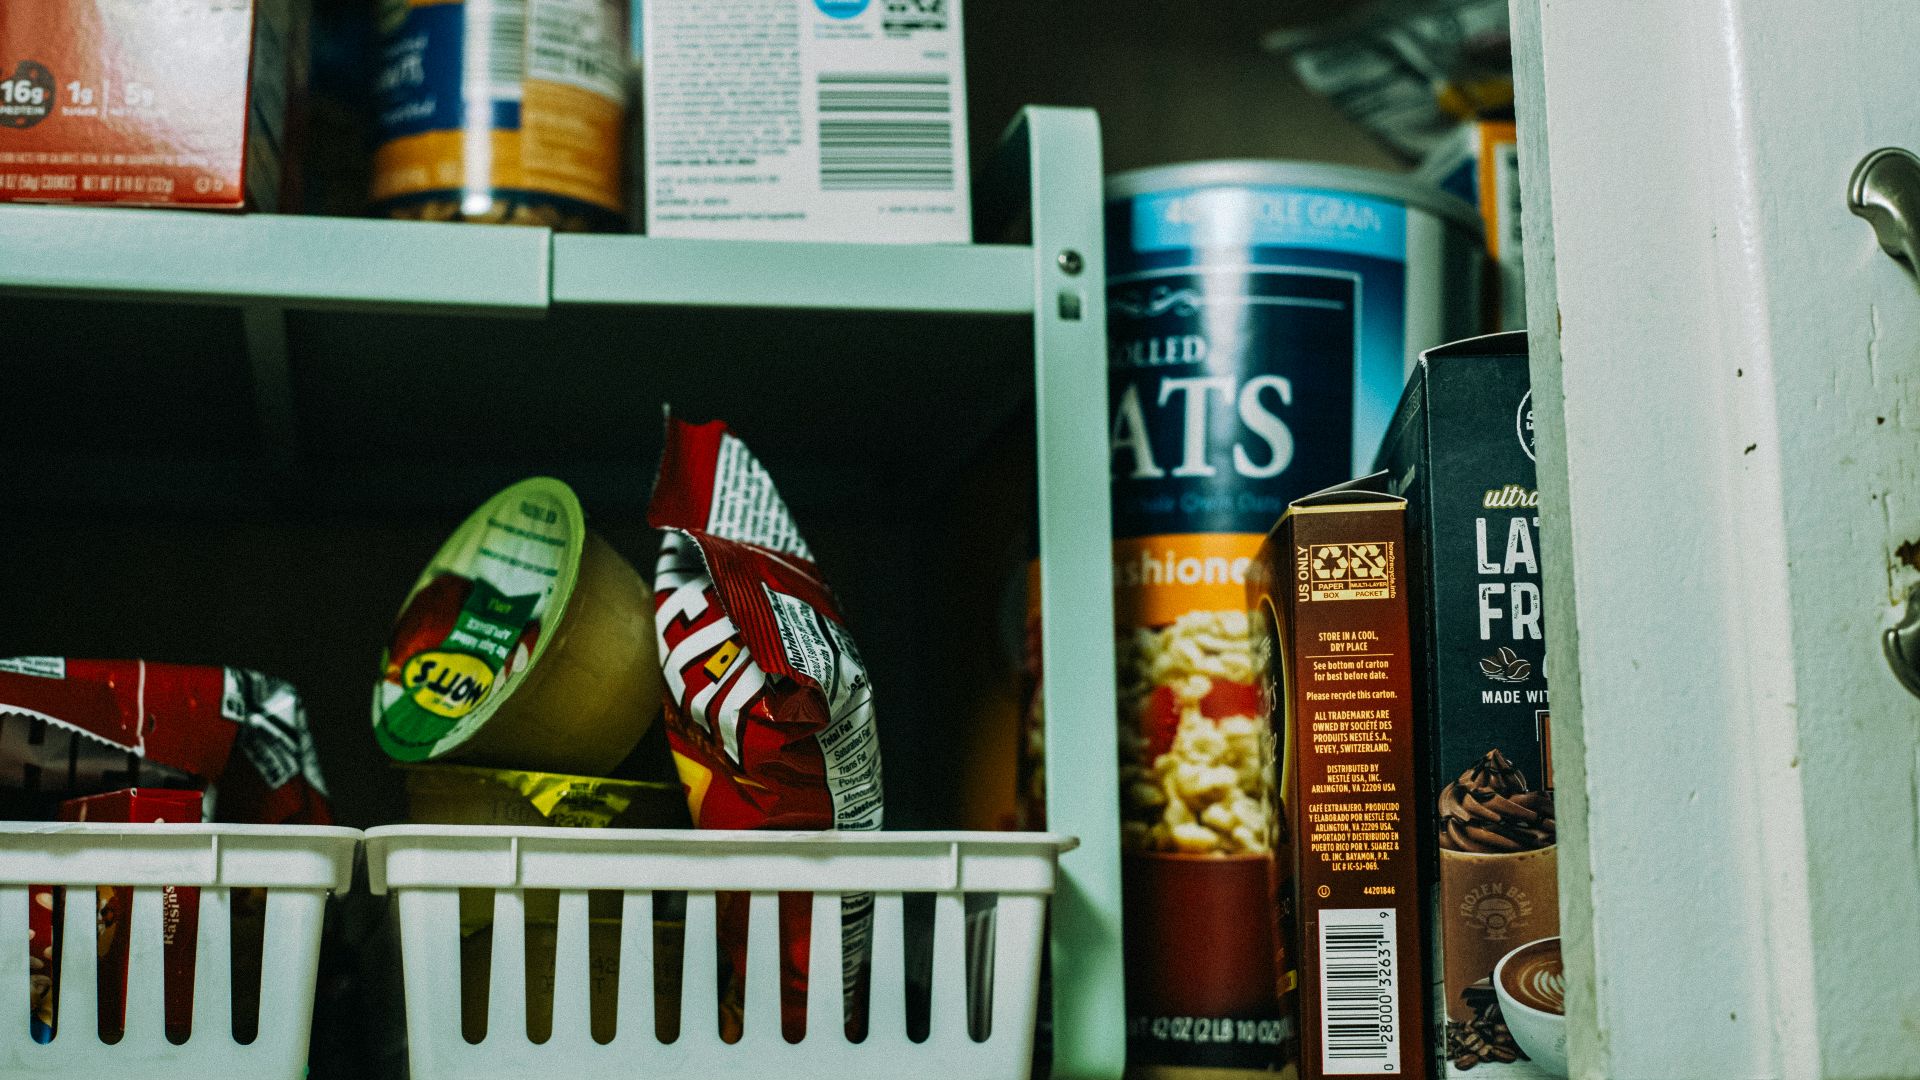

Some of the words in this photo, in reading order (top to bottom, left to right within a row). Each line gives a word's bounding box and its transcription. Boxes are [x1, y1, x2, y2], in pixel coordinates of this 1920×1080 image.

[0, 80, 44, 104] 16g
[66, 81, 93, 105] 1g
[1298, 546, 1309, 580] ONLY
[1388, 542, 1396, 598] how2recycle.info
[1299, 584, 1309, 602] US
[1479, 583, 1542, 640] FR
[1319, 632, 1340, 641] STORE
[1342, 632, 1350, 640] IN
[1352, 632, 1356, 640] A
[1358, 631, 1378, 640] COOL,
[1331, 643, 1345, 652] DRY
[1347, 642, 1368, 651] PLACE
[1314, 662, 1326, 670] See
[1328, 661, 1354, 670] bottom
[1356, 660, 1364, 668] of
[1366, 660, 1388, 668] carton
[1314, 673, 1325, 681] for
[1327, 672, 1342, 680] best
[1344, 671, 1368, 680] before
[1370, 671, 1388, 679] date.
[1306, 692, 1329, 700] Please
[1331, 691, 1356, 700] recycle
[1358, 690, 1370, 699] this
[1372, 690, 1397, 698] carton.
[1482, 691, 1520, 704] MADE
[1315, 712, 1327, 720] ALL
[1328, 710, 1374, 720] TRADEMARKS
[1376, 710, 1389, 718] ARE
[1313, 723, 1338, 731] OWNED
[1340, 722, 1349, 730] BY
[1351, 720, 1378, 730] SOCIÉTÉ
[1379, 721, 1392, 729] DES
[821, 728, 840, 748] Total
[839, 720, 853, 733] Fat
[1313, 733, 1348, 742] PRODUITS
[1350, 731, 1373, 741] NESTLÉ
[1375, 732, 1392, 742] S.A.,
[834, 734, 862, 761] Saturated
[1315, 745, 1339, 754] VEVEY,
[1340, 744, 1391, 752] SWITZERLAND.
[838, 759, 857, 775] Trans
[857, 751, 867, 765] Fat
[1327, 764, 1369, 773] DISTRIBUTED
[1370, 764, 1379, 772] BY
[1328, 773, 1350, 783] NESTLÉ
[1352, 775, 1367, 783] USA,
[1312, 785, 1350, 793] ARLINGTON,
[1352, 784, 1360, 792] VA
[1362, 784, 1381, 792] 22209
[1309, 802, 1322, 812] CAFÉ
[1324, 803, 1363, 812] EXTRANJERO.
[1365, 803, 1399, 811] PRODUCIDO
[1309, 814, 1313, 822] Y
[1315, 814, 1349, 822] ELABORADO
[1364, 812, 1384, 821] NESTLÉ
[1386, 813, 1400, 822] USA,
[837, 819, 873, 830] Sodium
[1316, 823, 1351, 832] ARLINGTON,
[1352, 823, 1360, 831] VA
[1311, 833, 1345, 841] IMPORTADO
[1347, 833, 1351, 841] Y
[1352, 832, 1389, 840] DISTRIBUIDO
[1391, 832, 1399, 840] EN
[1312, 843, 1334, 851] PUERTO
[1336, 843, 1349, 851] RICO
[1371, 842, 1393, 850] SUAREZ
[1395, 842, 1399, 850] &
[1321, 853, 1331, 861] CO.
[1333, 853, 1344, 861] INC.
[1346, 852, 1376, 861] BAYAMON,
[1378, 852, 1389, 860] P.R.
[1333, 863, 1341, 871] LIC
[1364, 886, 1396, 894] 44201846
[1460, 882, 1502, 917] FROZEN
[1506, 886, 1533, 917] BEAN
[164, 885, 180, 945] Raisins
[1378, 940, 1391, 986] 32631
[1380, 995, 1393, 1042] 28000
